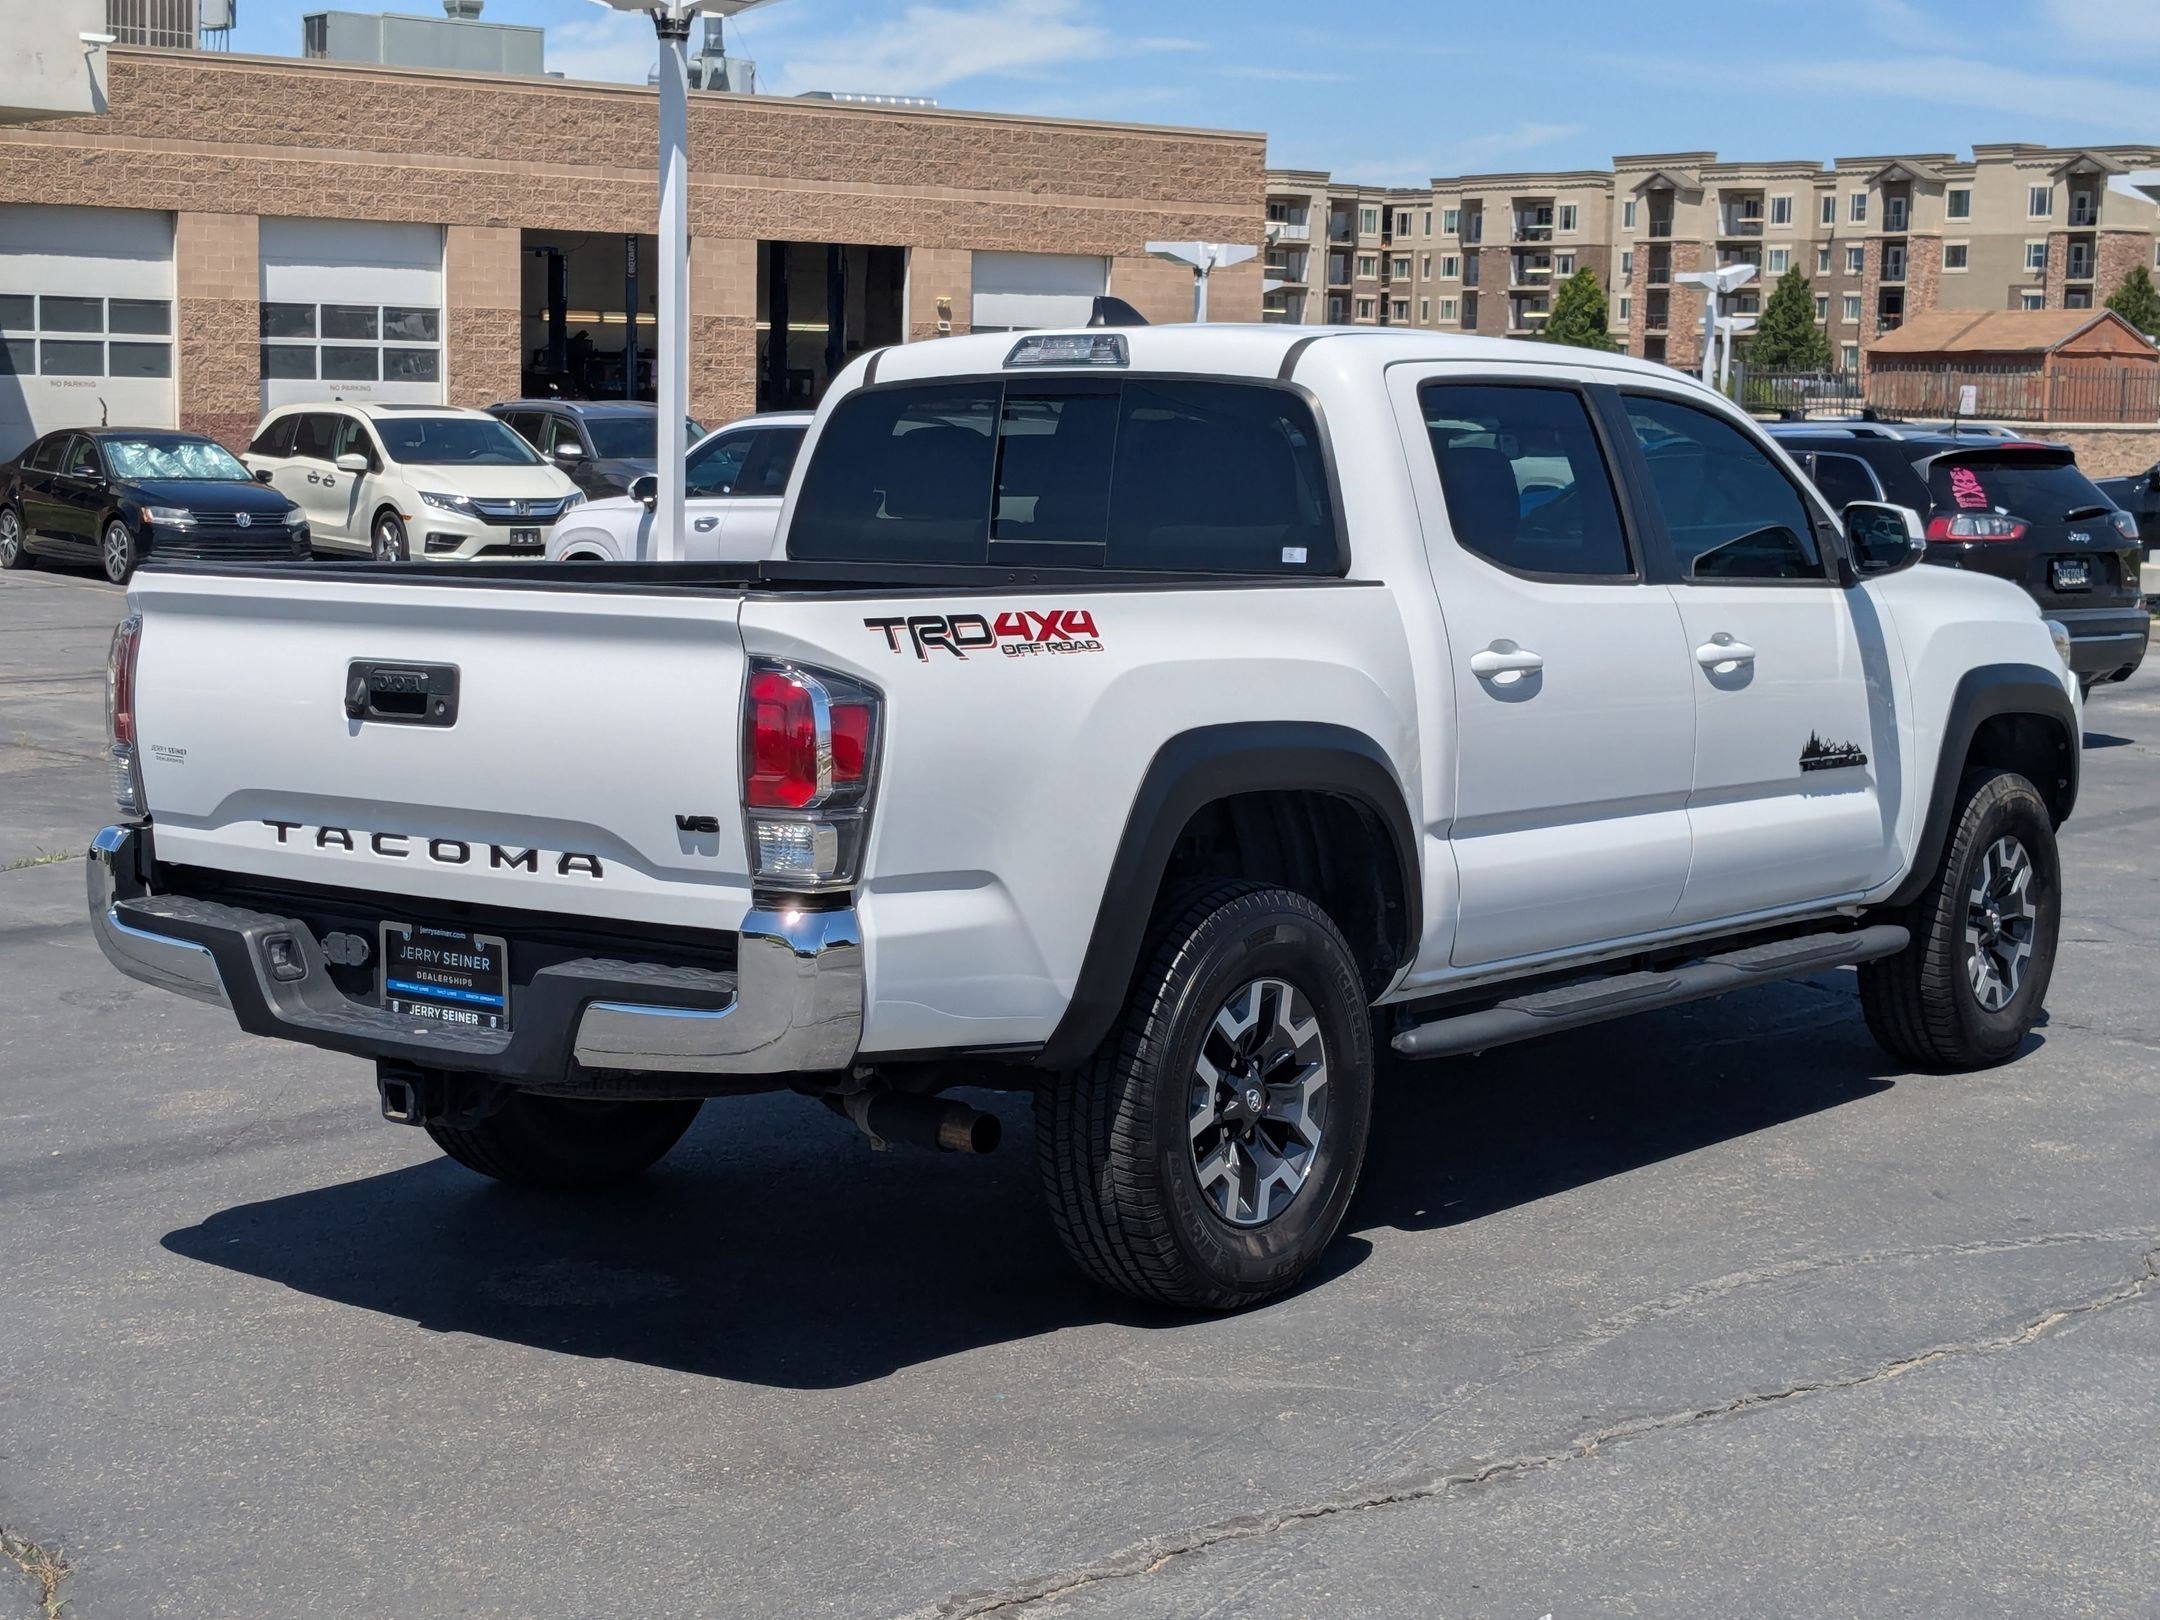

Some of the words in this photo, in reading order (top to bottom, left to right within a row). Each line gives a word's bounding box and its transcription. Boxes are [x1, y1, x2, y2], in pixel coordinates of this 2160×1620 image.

[50, 380, 62, 388] NO
[63, 380, 97, 388] PARKING
[863, 613, 997, 662] TRD
[1001, 642, 1045, 658] OFF
[1046, 639, 1105, 656] ROAD
[674, 814, 720, 833] V6
[262, 819, 604, 879] TACOMA
[420, 926, 466, 939] jerryseiner.com
[400, 945, 440, 963] JERRY
[443, 951, 490, 971] SEINER
[416, 971, 473, 986] DEALERSHIPS
[409, 1004, 440, 1018] JERRY
[442, 1009, 479, 1025] SEINER
